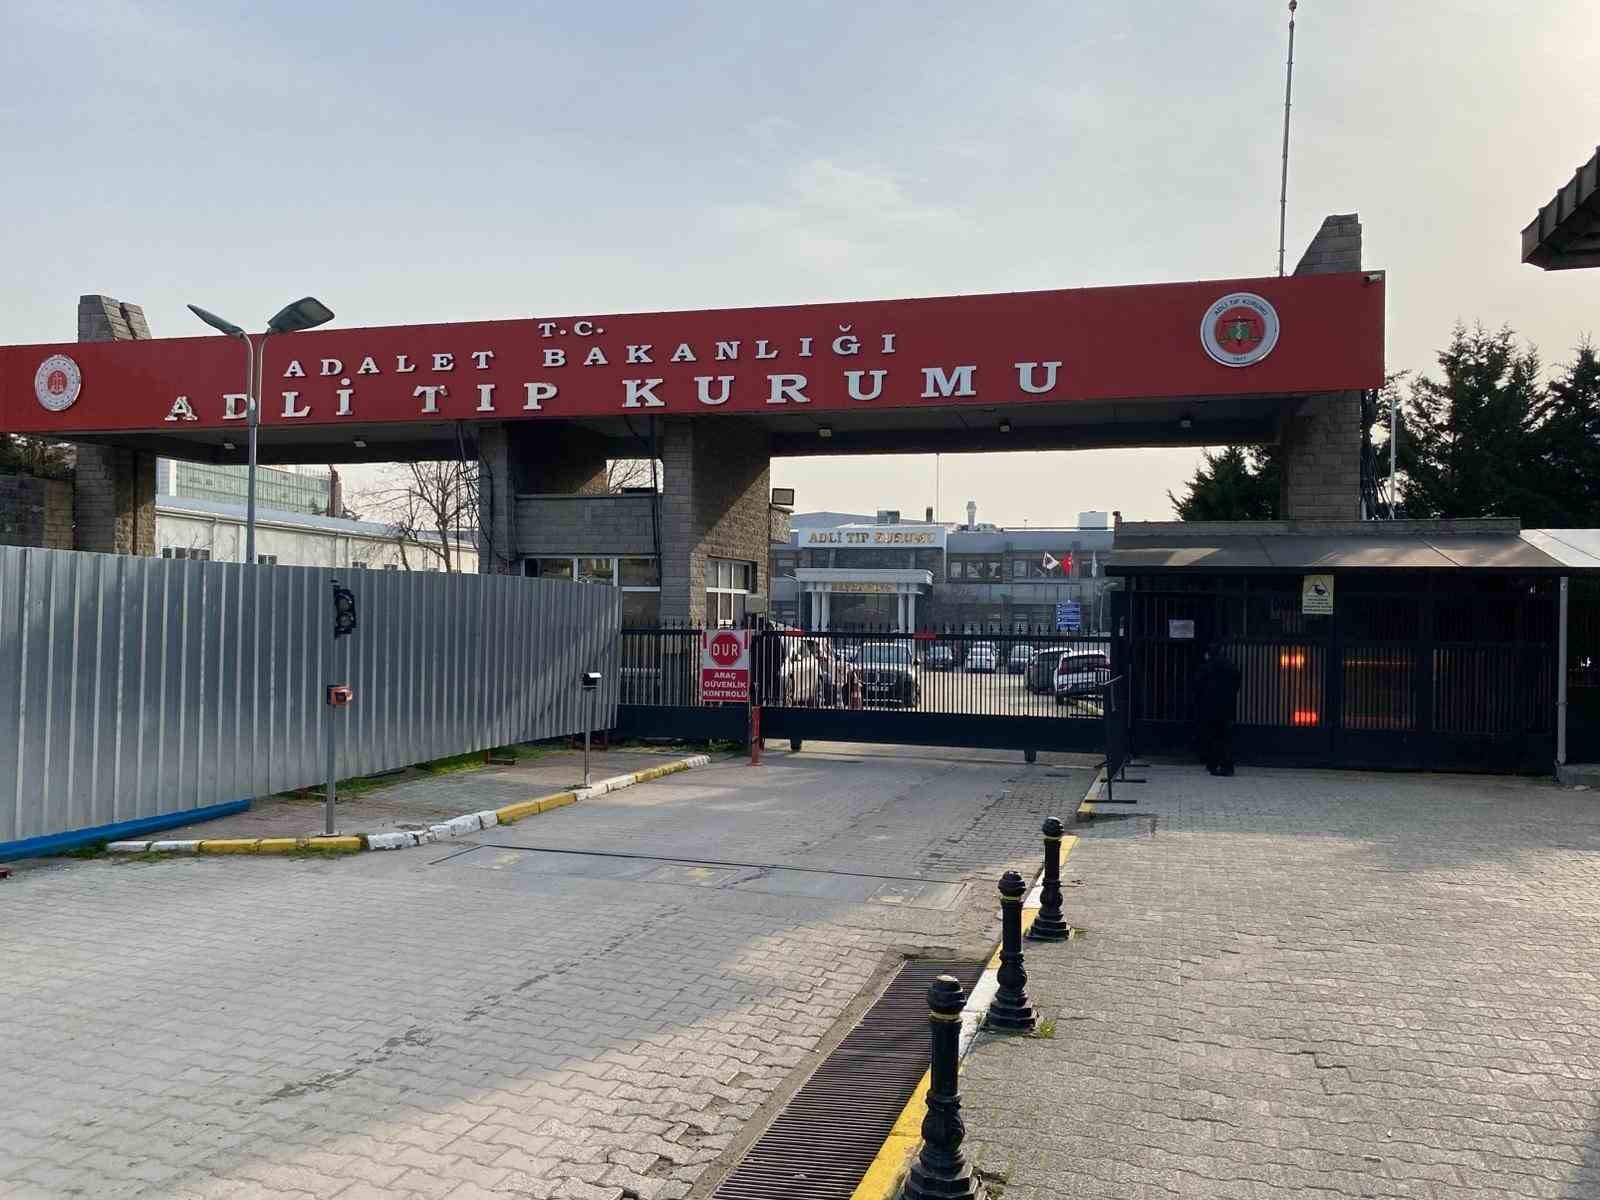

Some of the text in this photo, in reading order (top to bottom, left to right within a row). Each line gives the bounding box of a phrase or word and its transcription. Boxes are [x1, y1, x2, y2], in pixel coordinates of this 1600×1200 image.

[537, 322, 605, 338] T.C.
[283, 324, 896, 378] ADALET BAKANLIĞI
[165, 361, 1063, 422] ADLİ TIP KURUMU
[847, 532, 870, 544] TIP
[712, 643, 738, 656] DUR
[714, 672, 737, 680] ARAÇ
[704, 680, 747, 688] GÜVENLİK
[703, 689, 747, 698] KONTROLÜ
